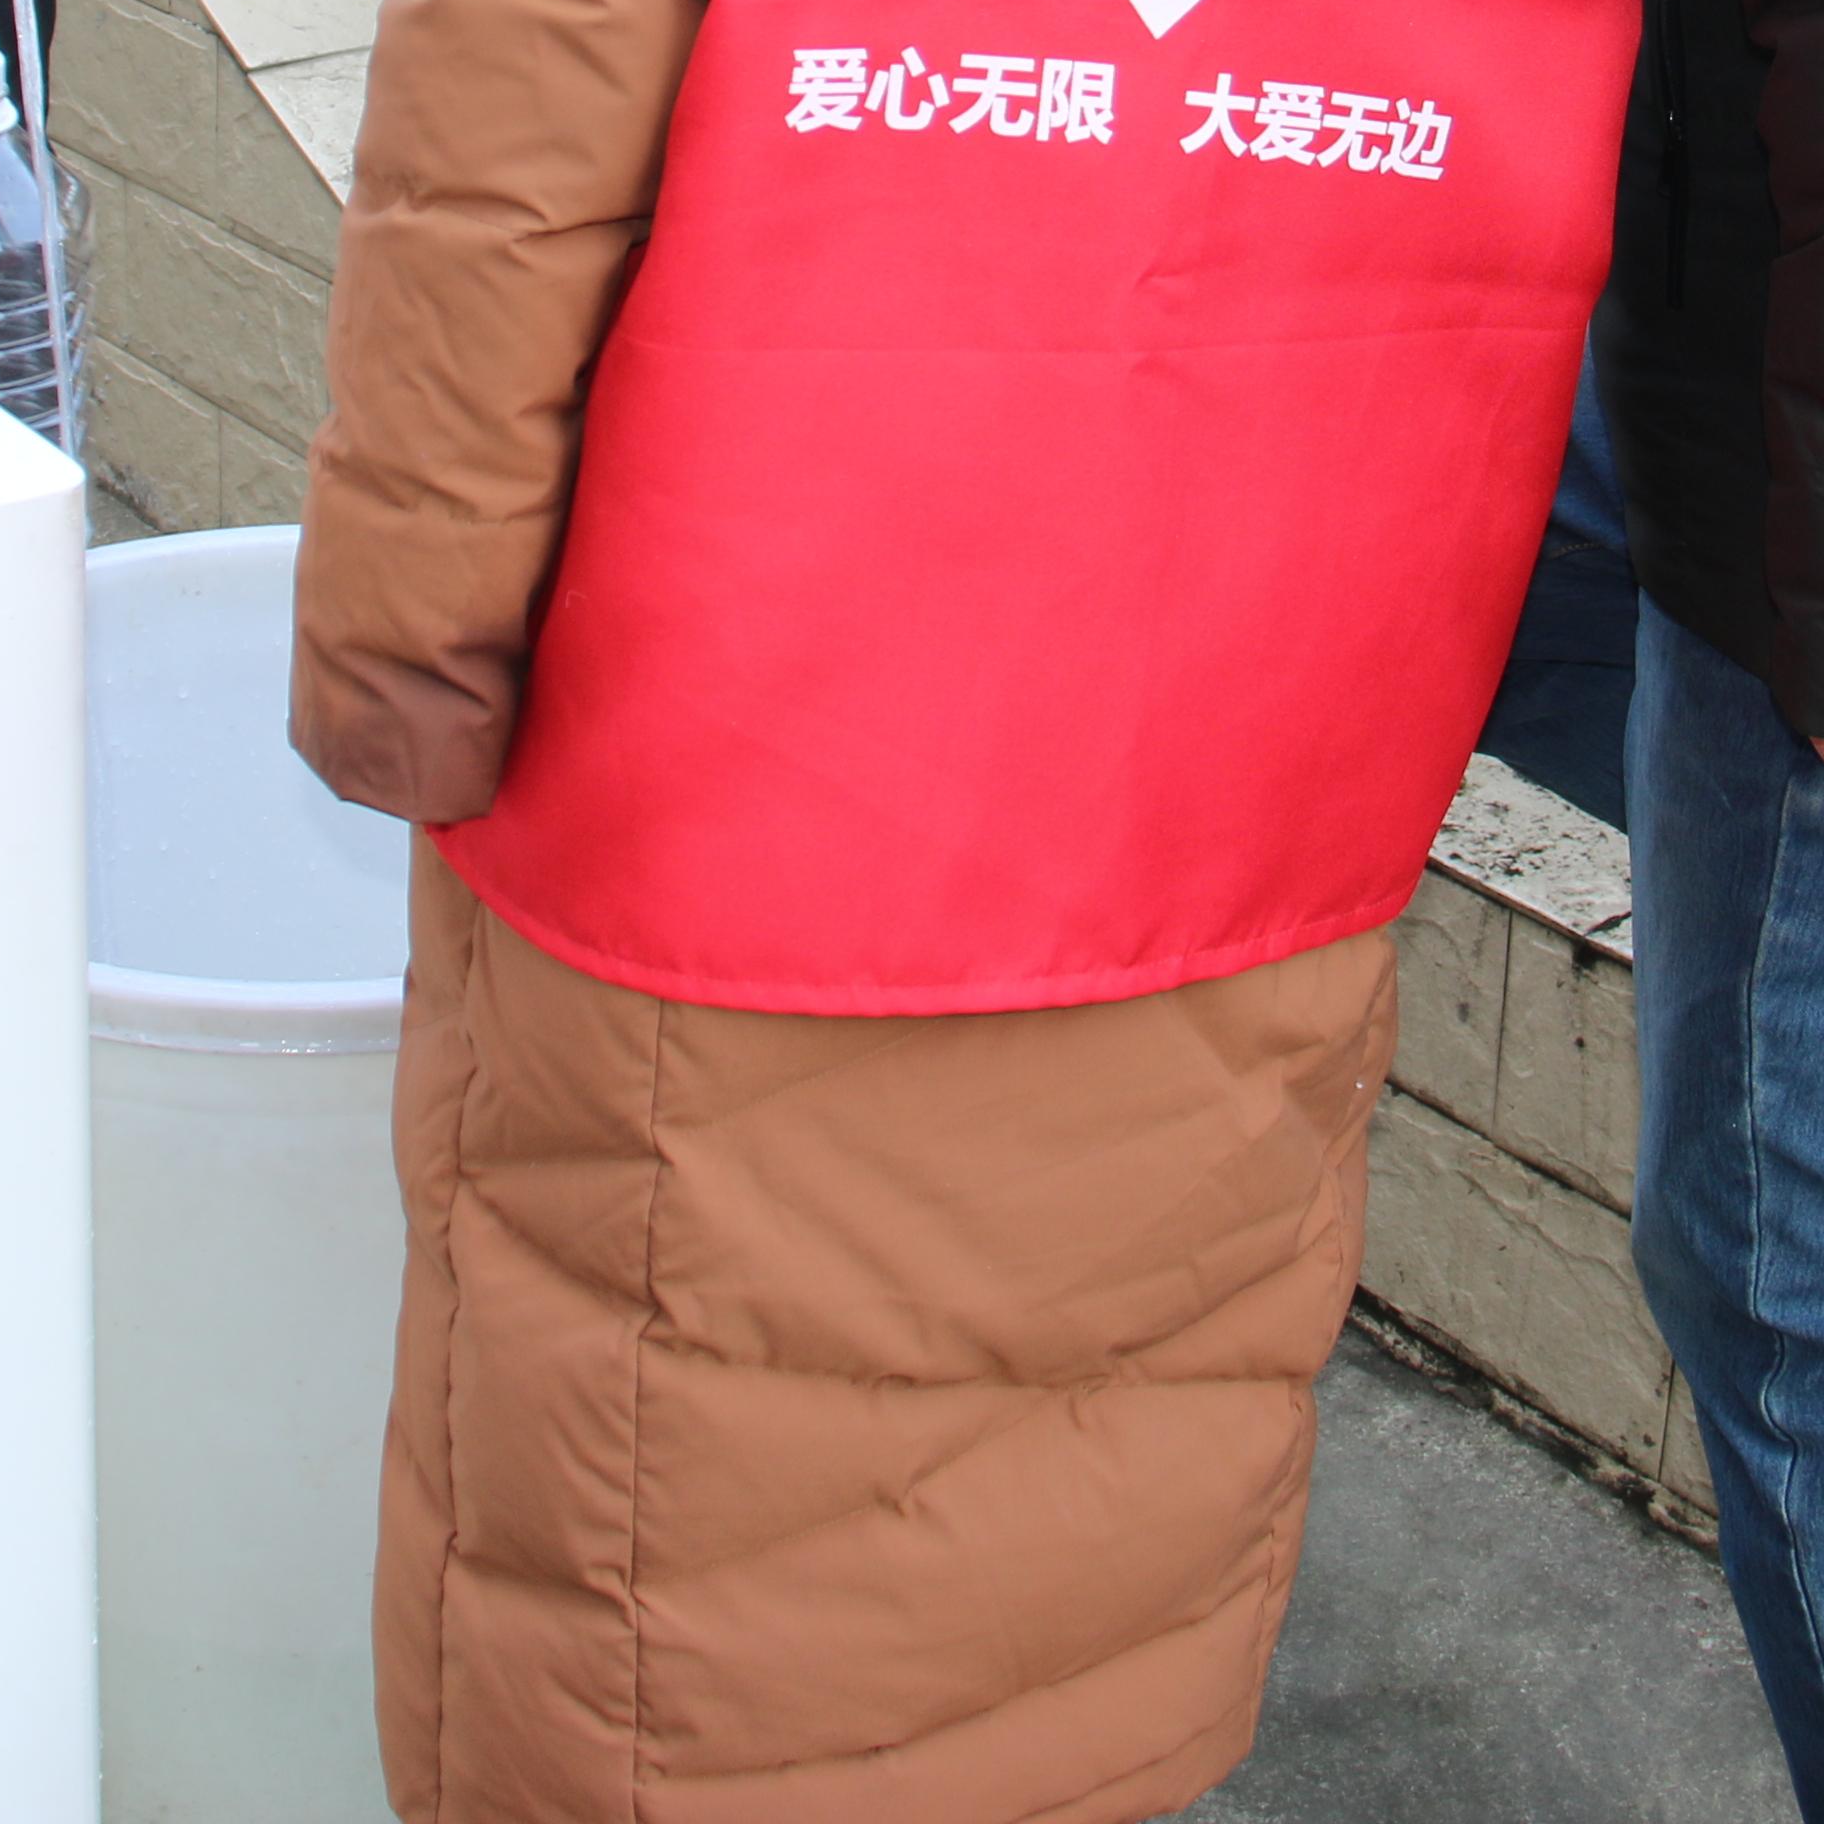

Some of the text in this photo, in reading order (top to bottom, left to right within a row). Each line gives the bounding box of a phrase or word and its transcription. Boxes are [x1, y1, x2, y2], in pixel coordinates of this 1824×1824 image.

[784, 46, 1452, 180] 爱心无限 大爱无边
